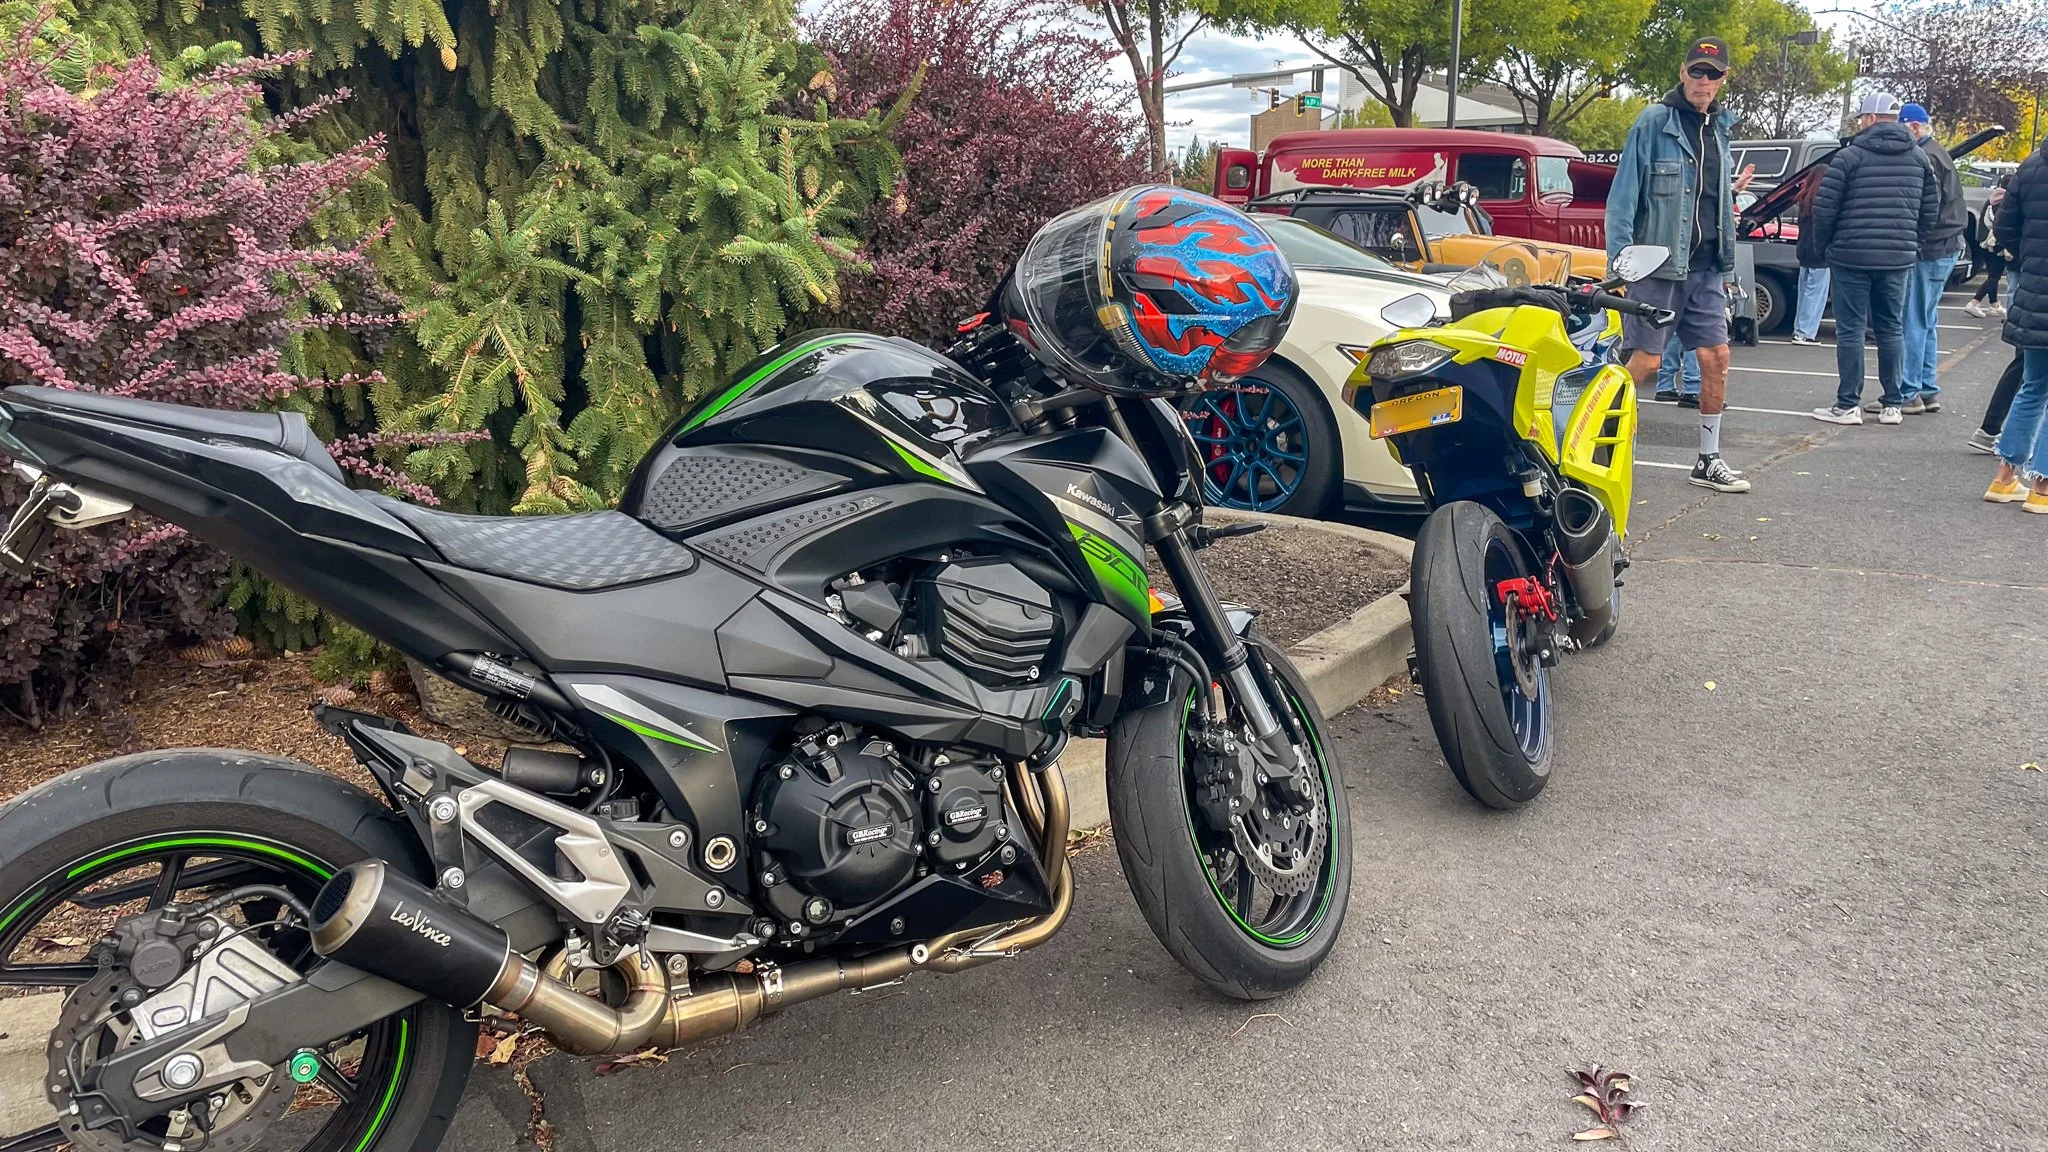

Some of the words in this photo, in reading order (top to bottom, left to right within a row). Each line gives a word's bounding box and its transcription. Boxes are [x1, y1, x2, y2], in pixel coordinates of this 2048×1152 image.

[1302, 158, 1334, 169] MORE
[1335, 157, 1365, 168] THAN
[1322, 168, 1386, 179] DAIRY-FREE
[1388, 167, 1417, 178] MILK
[1495, 347, 1527, 365] MOTUL
[1391, 391, 1440, 406] OREGON
[1066, 483, 1115, 517] Kawasaki
[852, 827, 888, 840] GBRacing
[390, 900, 451, 947] LeoVince
